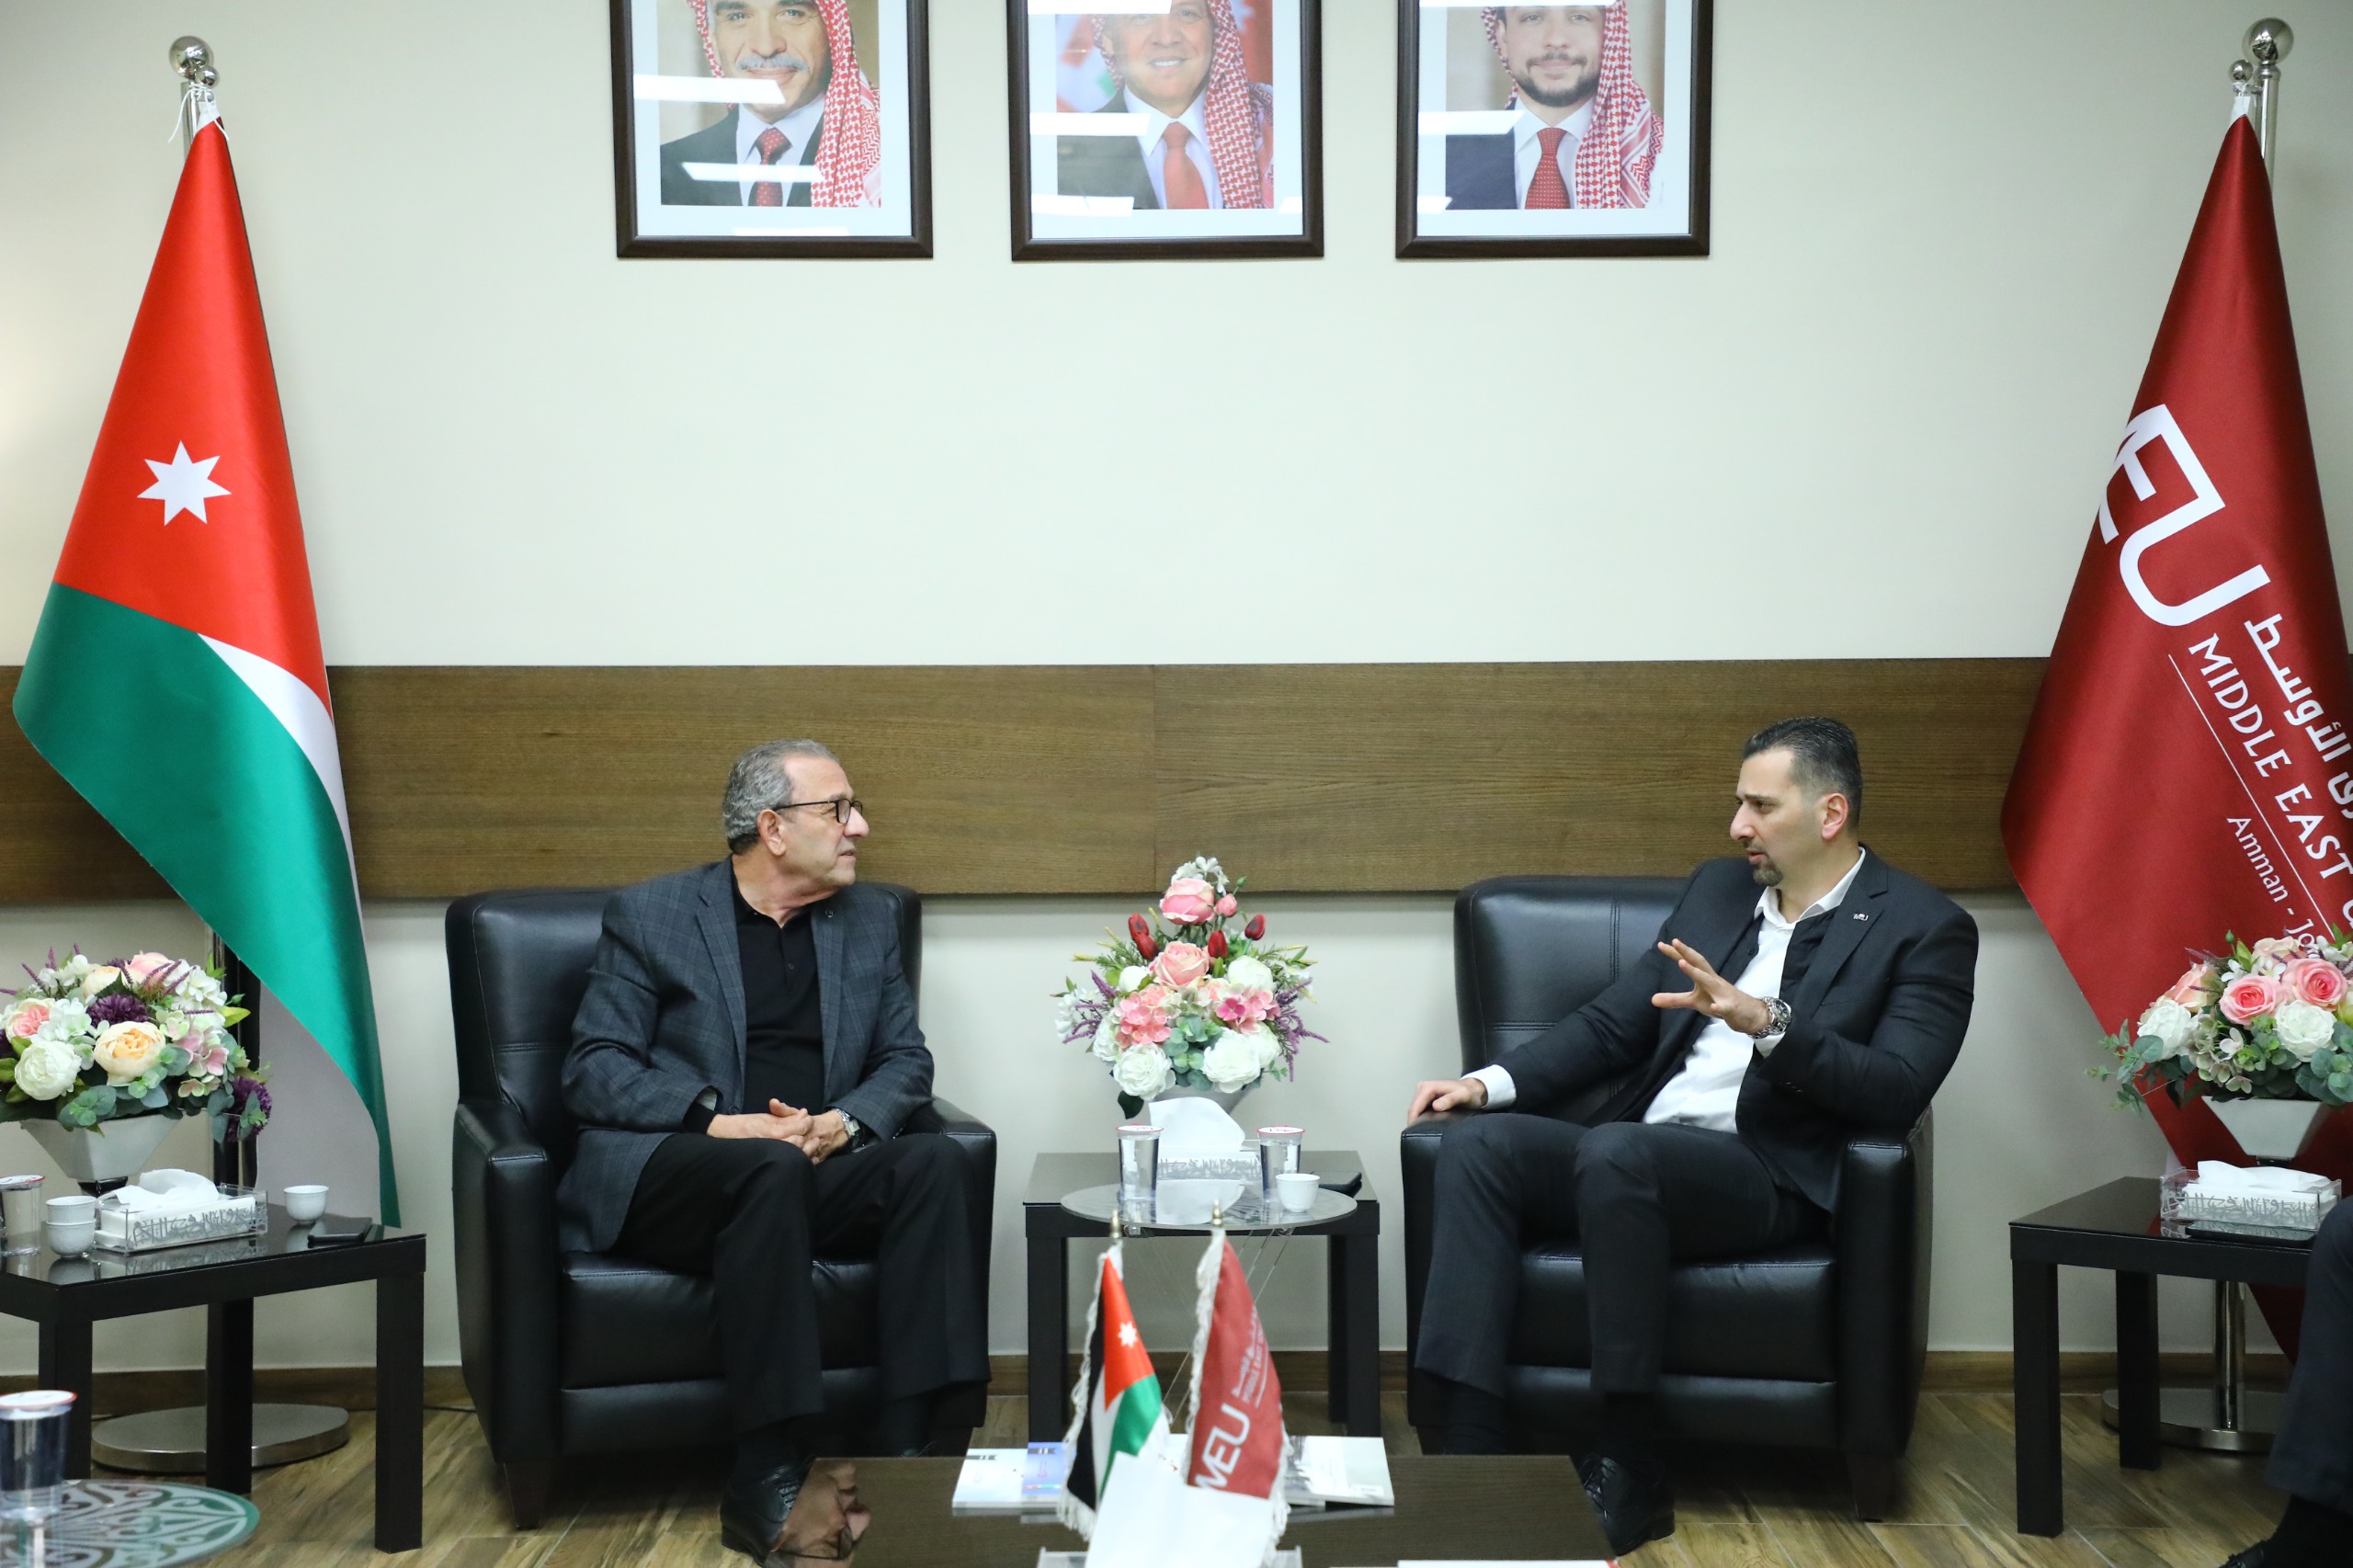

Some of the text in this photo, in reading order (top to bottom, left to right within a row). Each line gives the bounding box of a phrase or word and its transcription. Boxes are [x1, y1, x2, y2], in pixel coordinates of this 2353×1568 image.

[2098, 403, 2270, 627] EU
[2188, 632, 2353, 880] MIDDLE EAST
[2244, 613, 2352, 763] الأوسط
[2227, 816, 2289, 903] Amman
